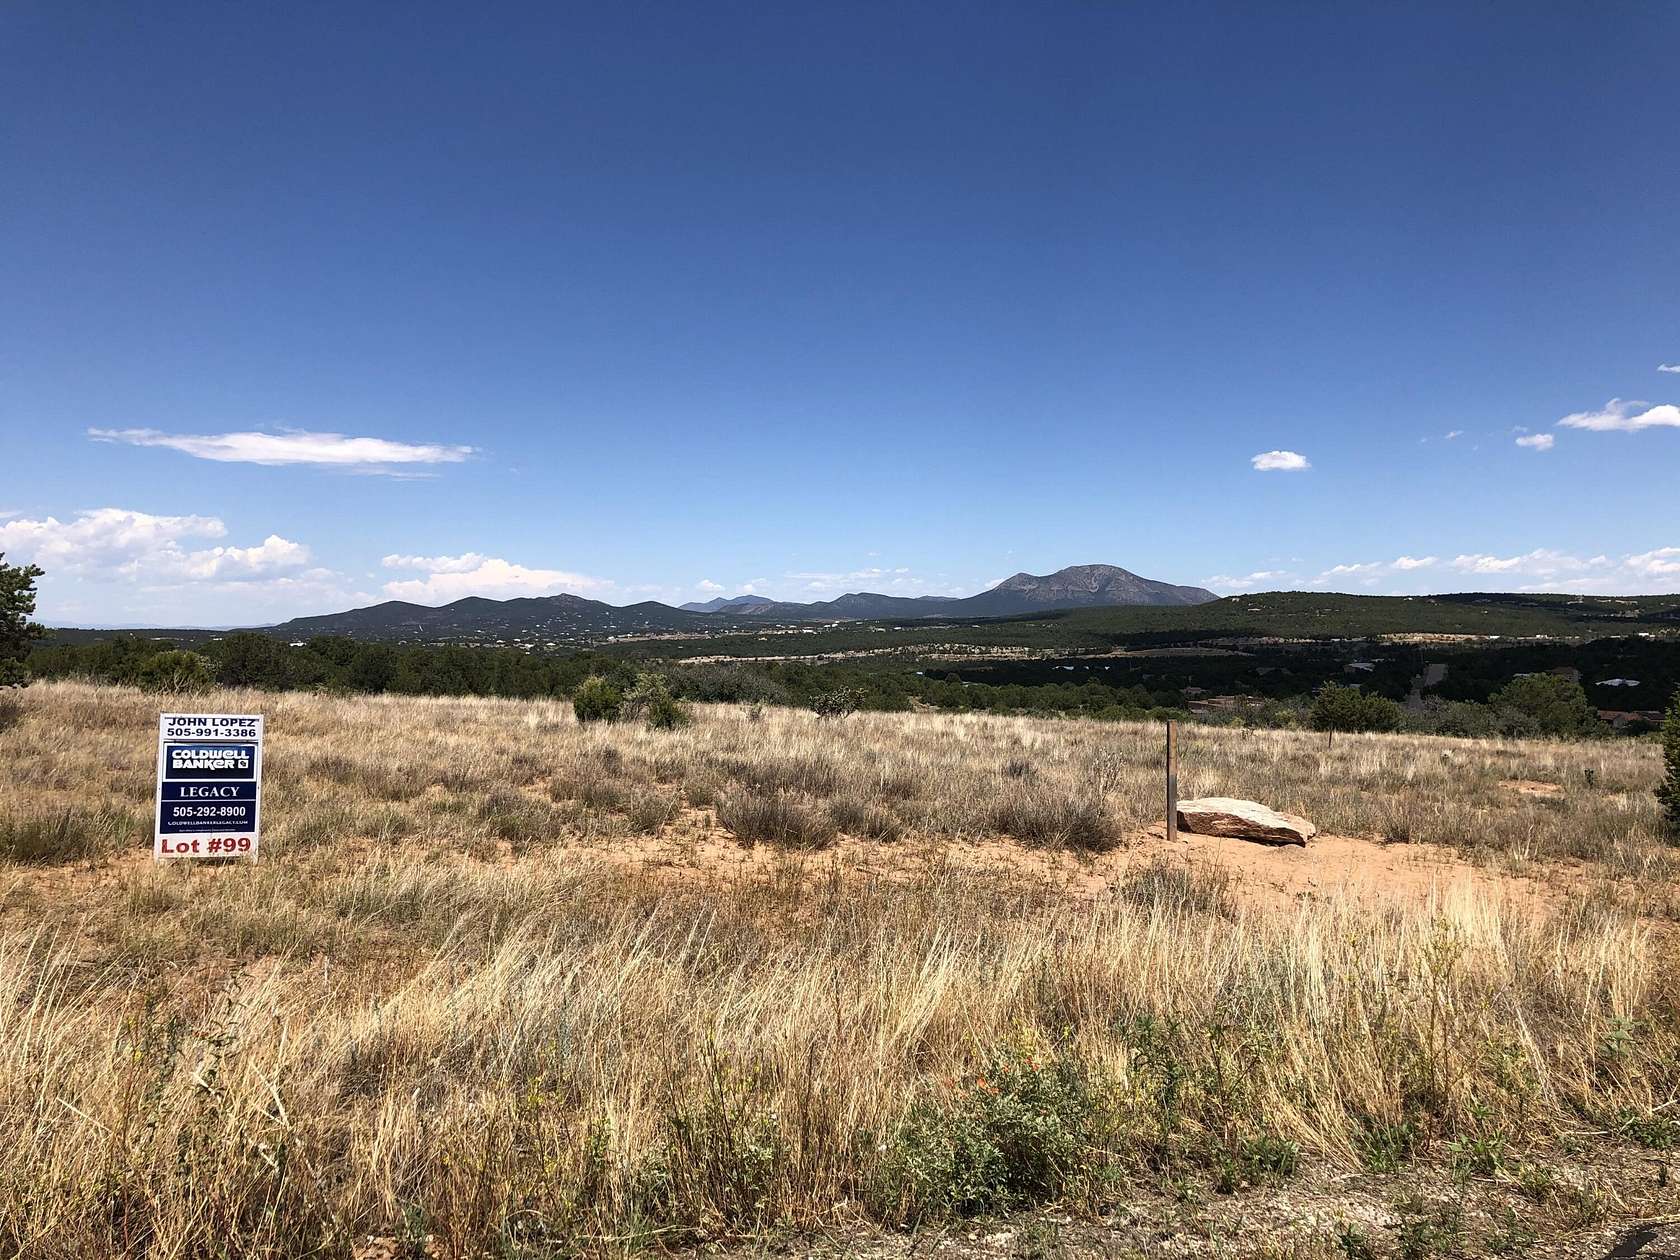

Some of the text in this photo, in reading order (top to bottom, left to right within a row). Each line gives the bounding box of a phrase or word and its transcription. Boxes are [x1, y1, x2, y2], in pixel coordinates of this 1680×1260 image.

[168, 717, 256, 728] JOHN LOPEZ
[167, 728, 257, 737] 505-991-3386
[180, 786, 240, 798] LEGACY
[172, 806, 246, 817] 505-292-8900
[161, 837, 251, 853] Lot #99
